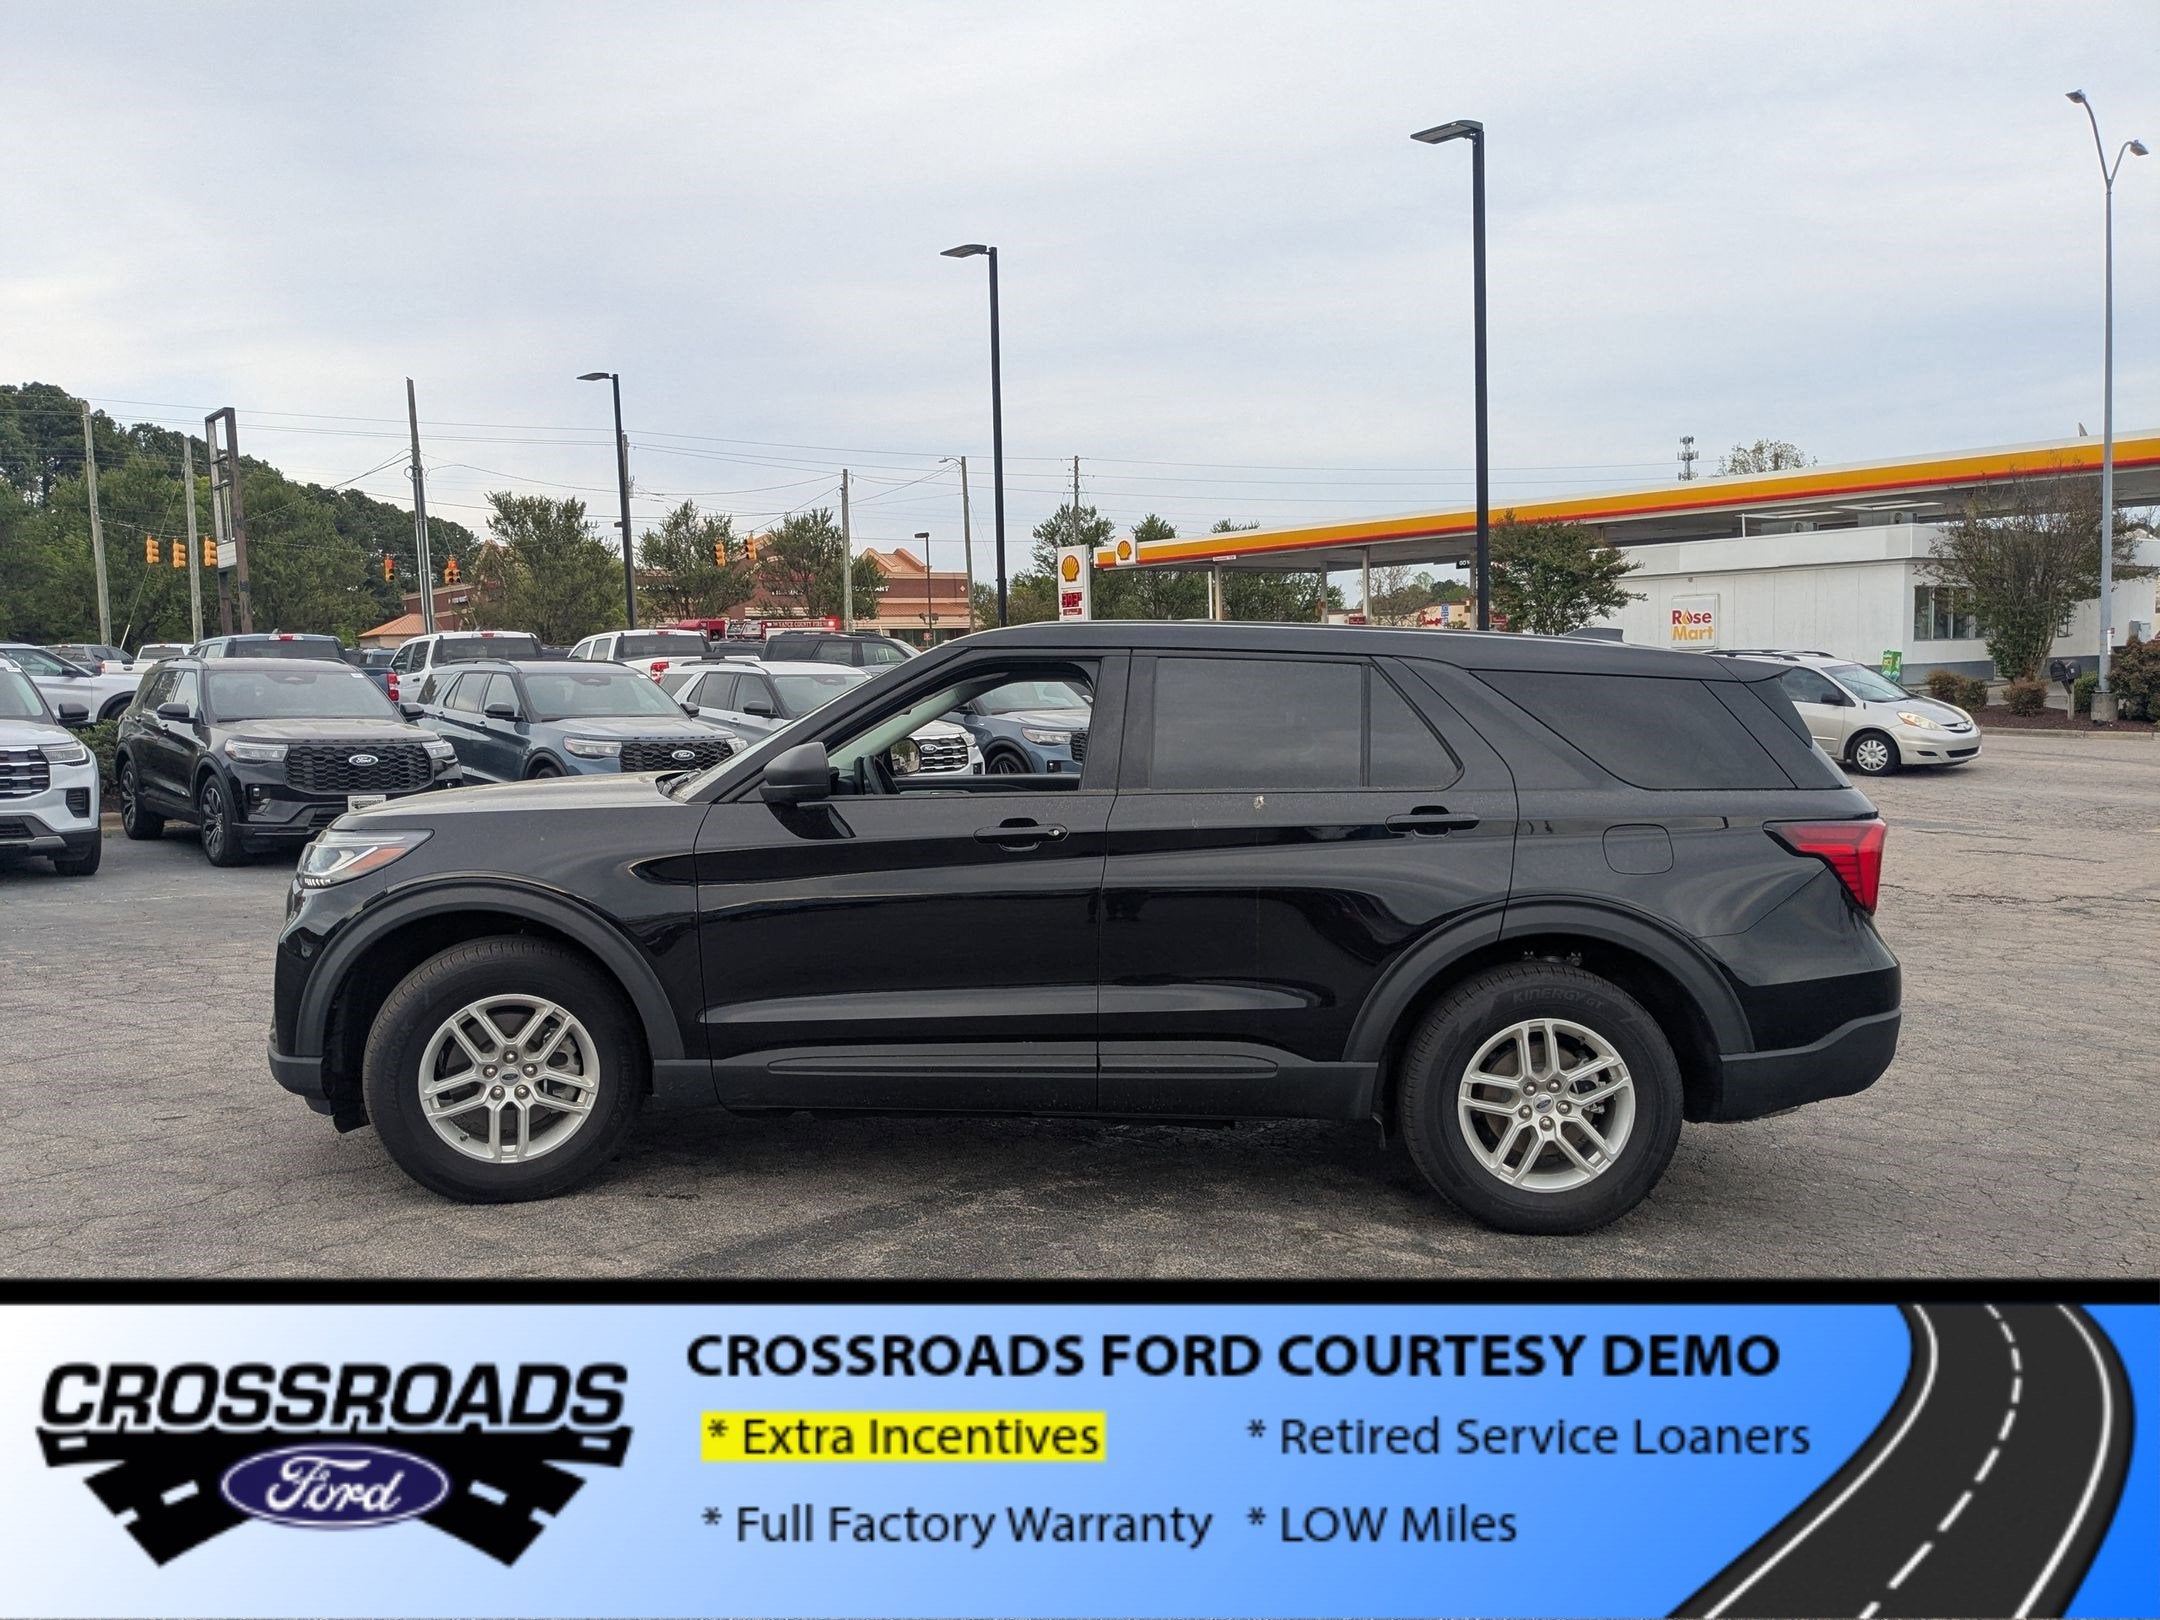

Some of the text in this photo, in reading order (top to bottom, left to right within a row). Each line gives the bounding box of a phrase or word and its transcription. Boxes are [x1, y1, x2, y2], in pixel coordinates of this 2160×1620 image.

[1672, 608, 1712, 625] Rose
[1672, 626, 1714, 641] Mart
[1512, 987, 1586, 1005] KINERGY
